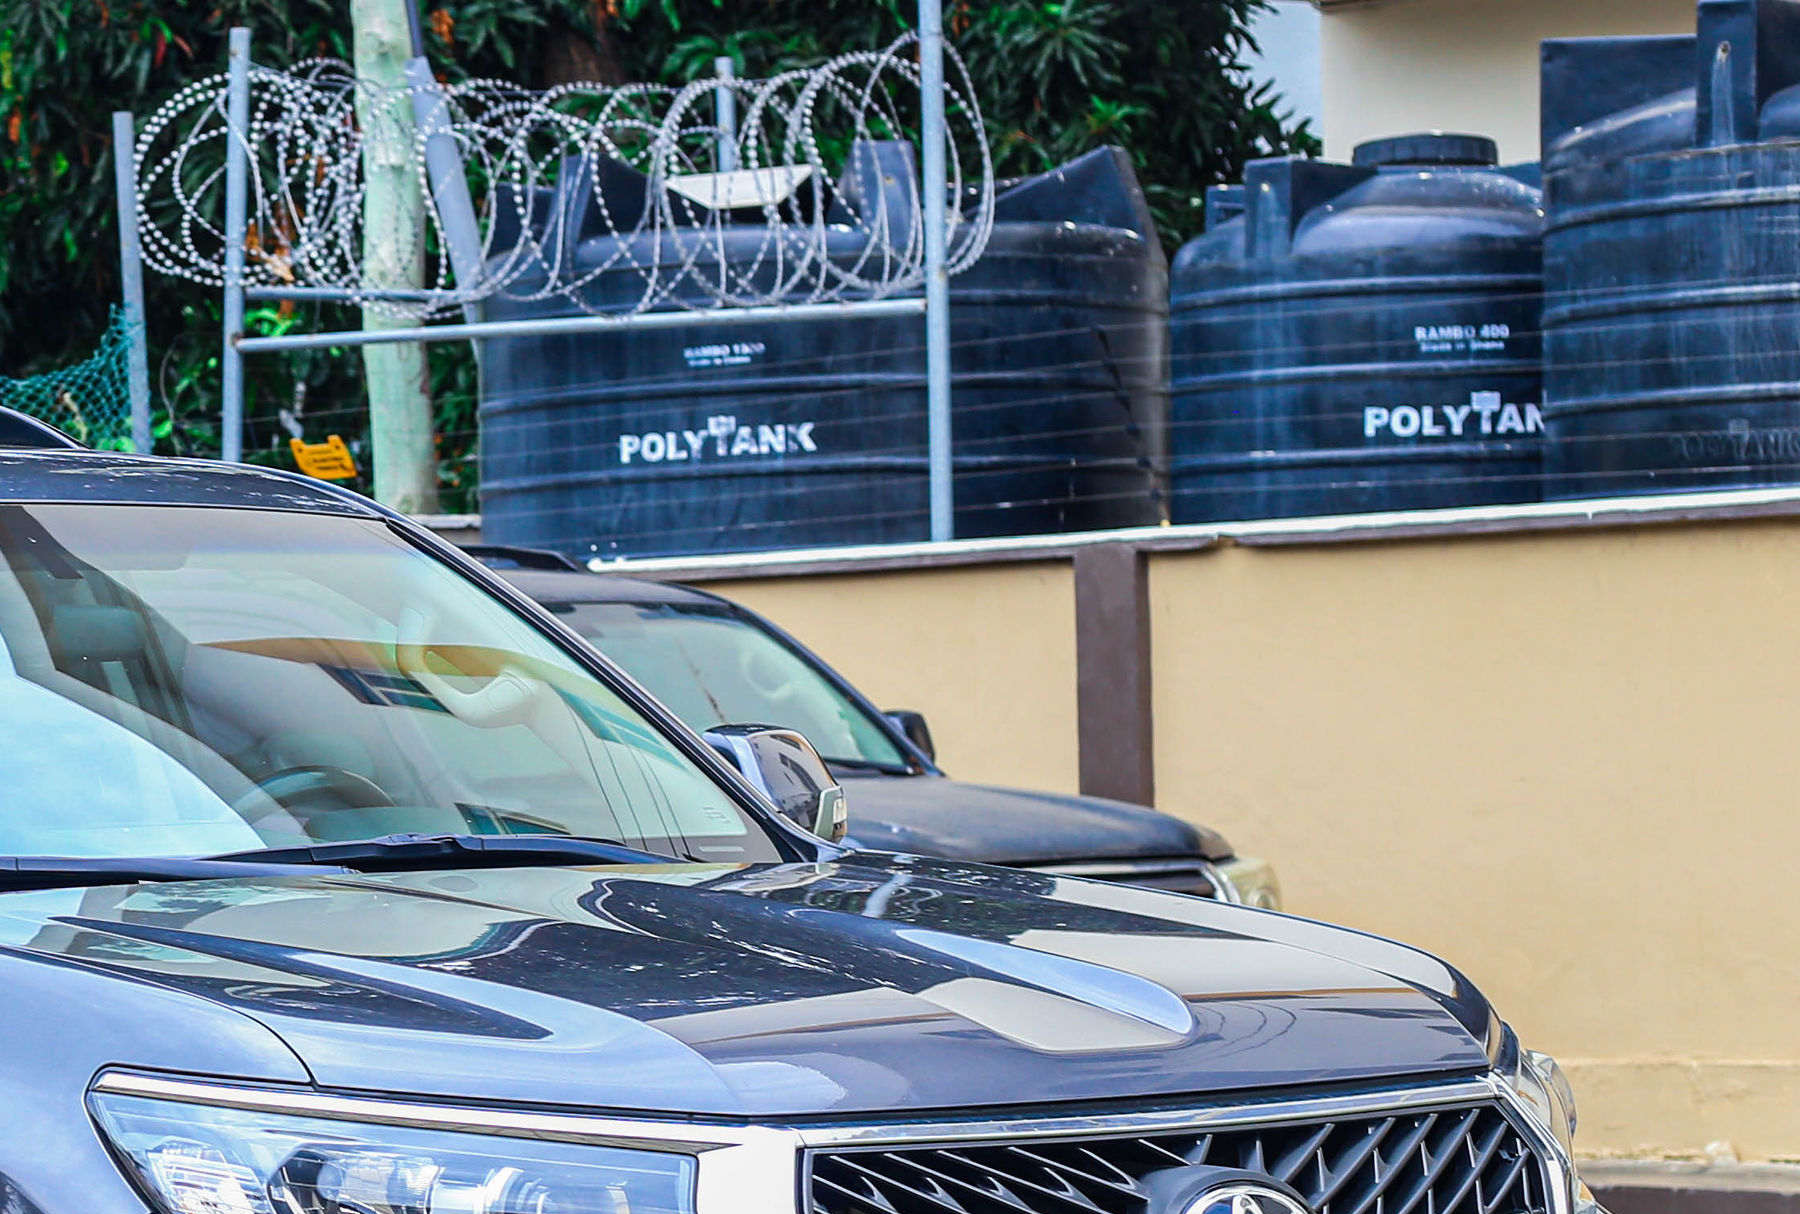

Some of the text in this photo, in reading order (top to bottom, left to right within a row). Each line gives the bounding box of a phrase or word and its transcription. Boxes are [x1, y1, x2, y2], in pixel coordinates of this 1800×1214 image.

[1414, 323, 1510, 341] RAMBO 400
[1364, 390, 1545, 437] POLYTAN
[619, 415, 818, 464] POLYTANK
